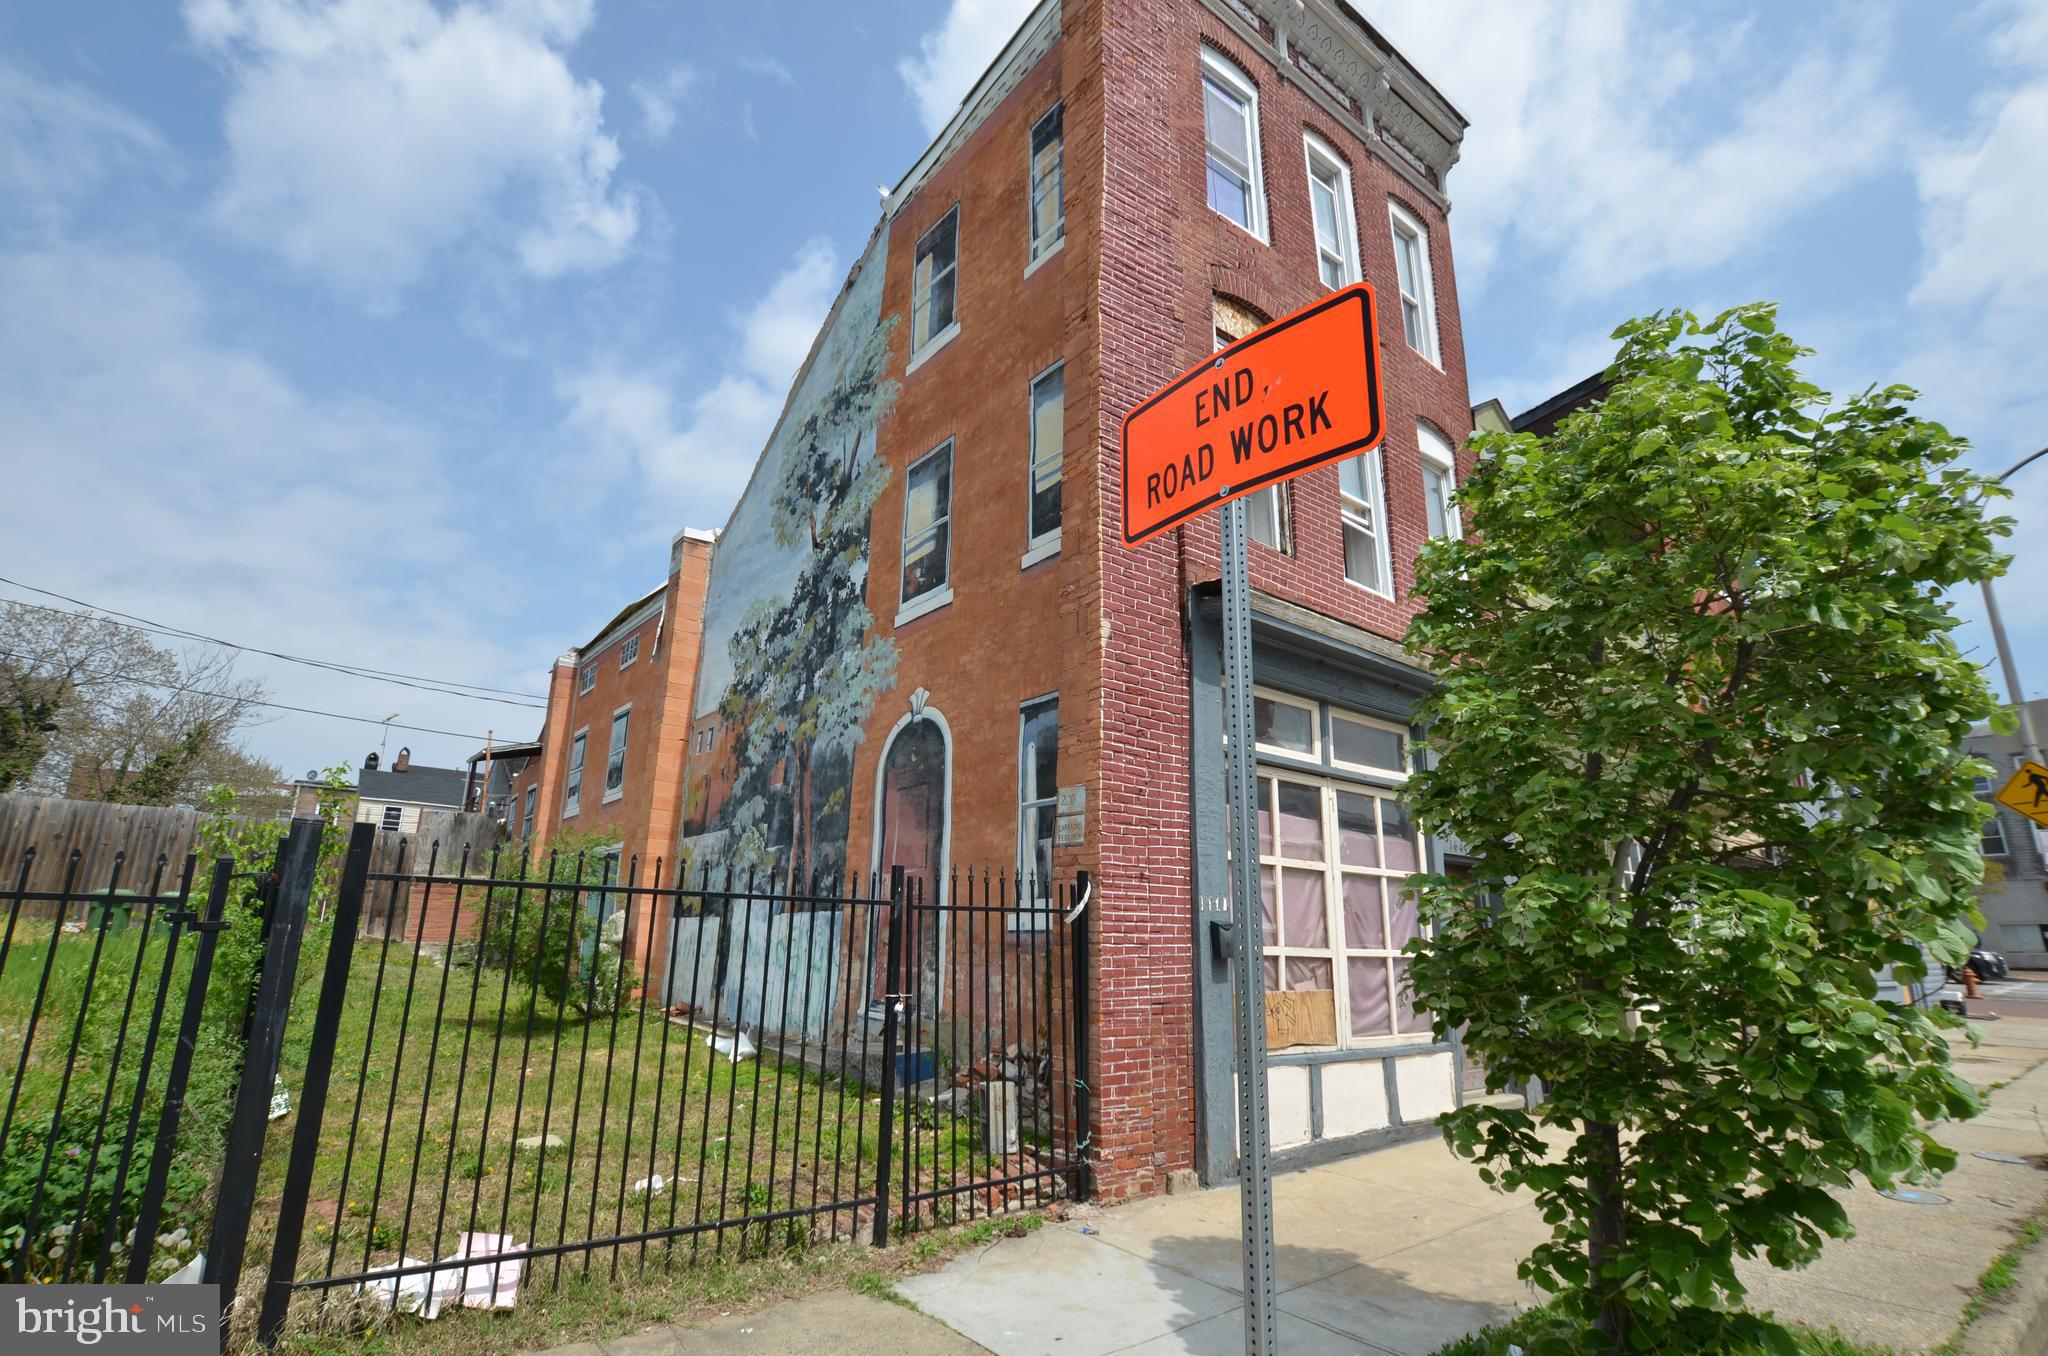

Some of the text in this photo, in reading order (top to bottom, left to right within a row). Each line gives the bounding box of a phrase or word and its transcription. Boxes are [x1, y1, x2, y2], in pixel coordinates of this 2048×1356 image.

[1195, 367, 1254, 428] END
[1147, 390, 1333, 509] ROAD WORK
